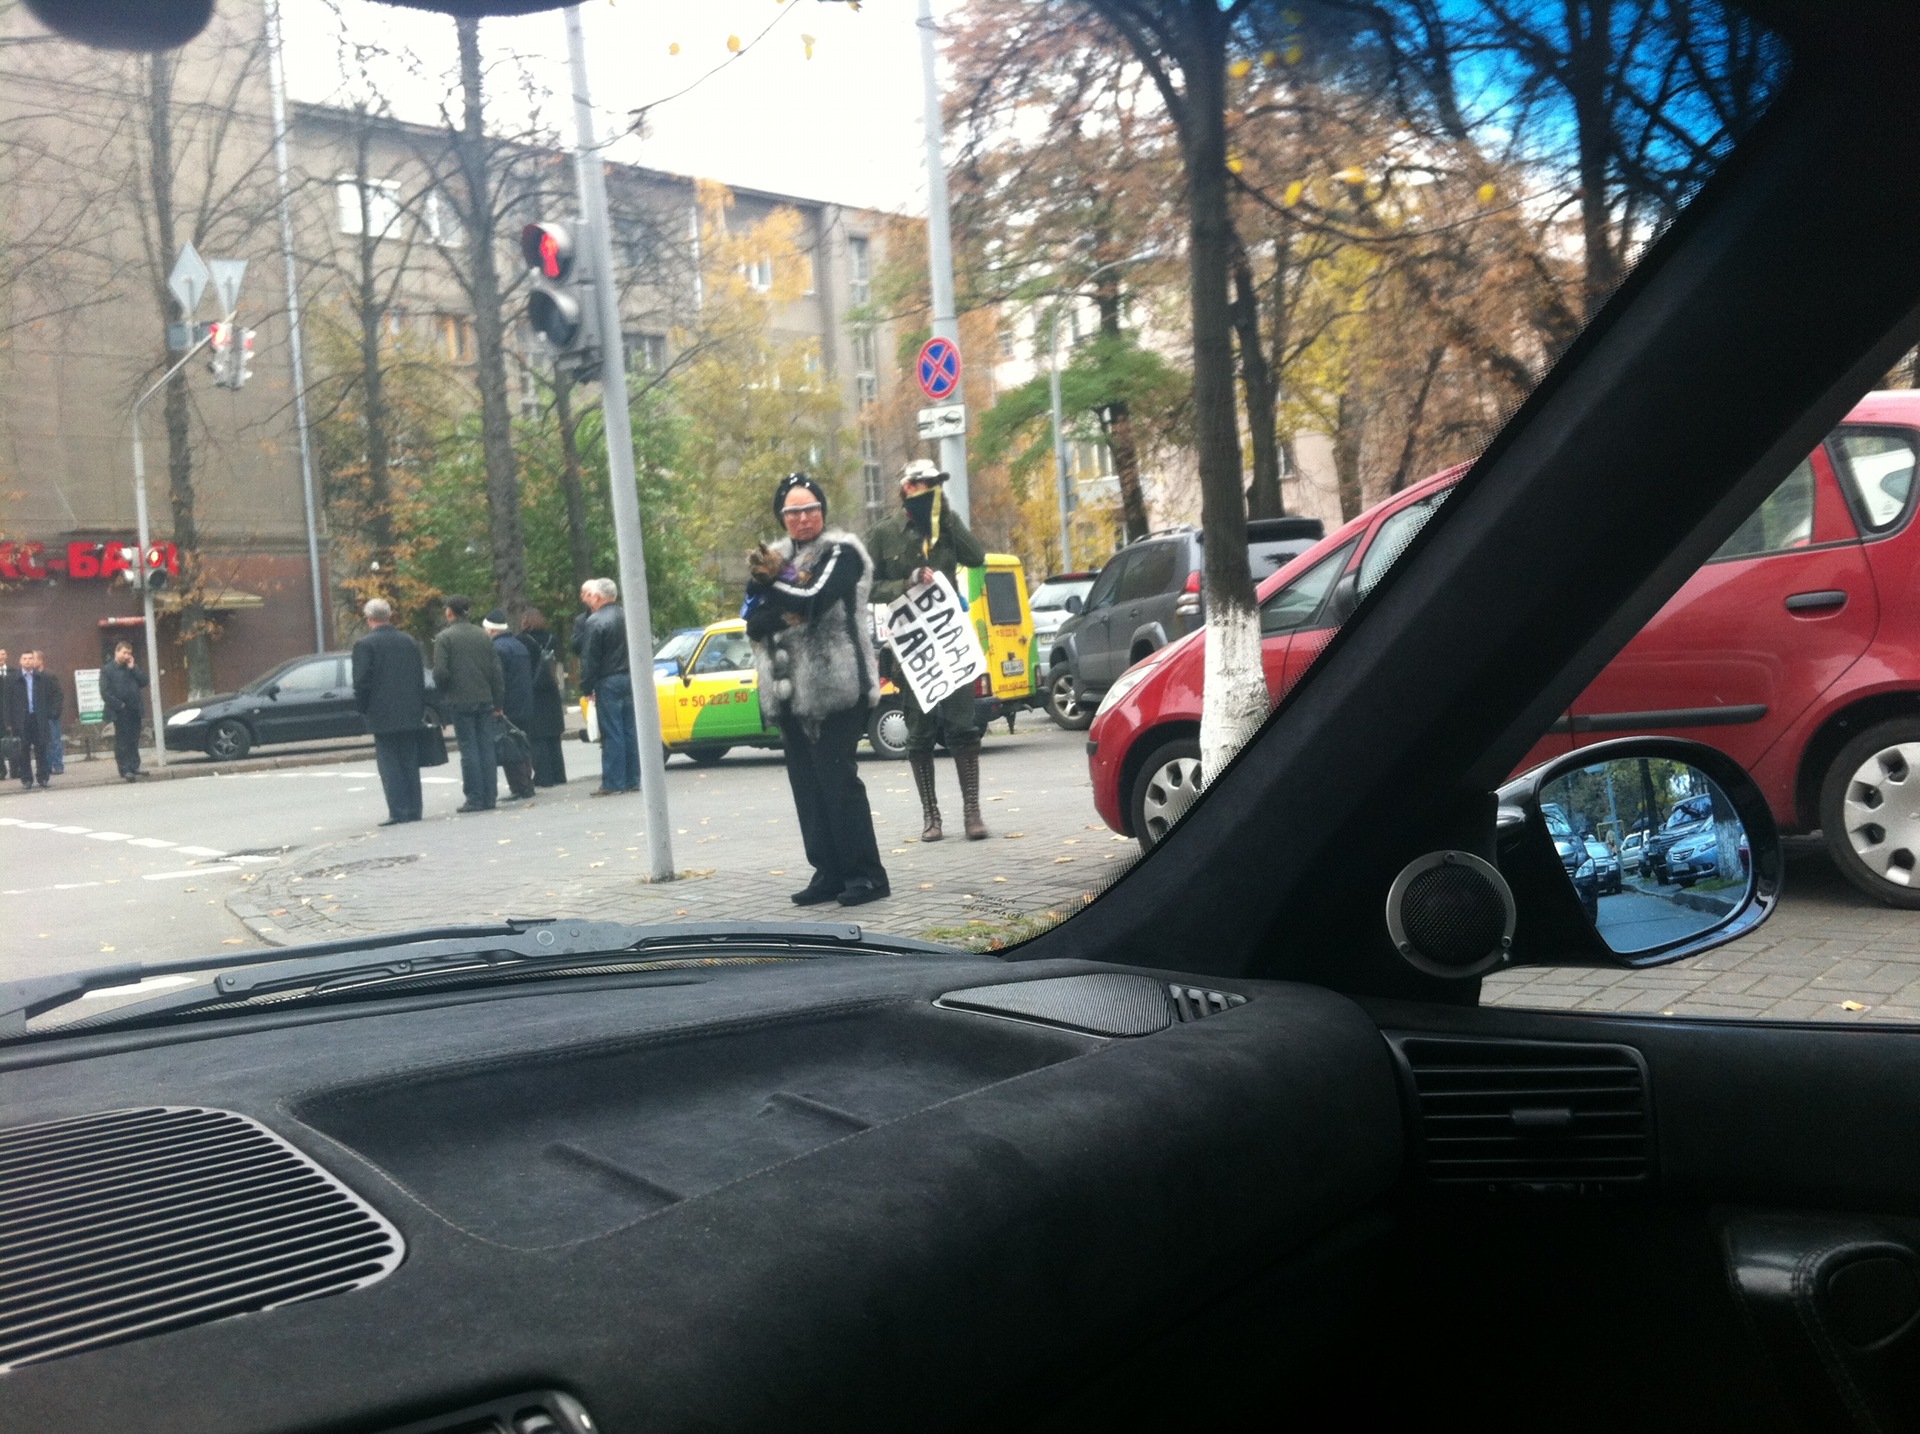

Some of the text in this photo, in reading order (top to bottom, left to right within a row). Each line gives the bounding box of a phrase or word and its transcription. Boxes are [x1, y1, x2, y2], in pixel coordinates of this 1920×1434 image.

[887, 604, 949, 704] ГАВНО
[914, 584, 977, 684] ВЛАДА
[692, 691, 748, 707] 50 222 50
